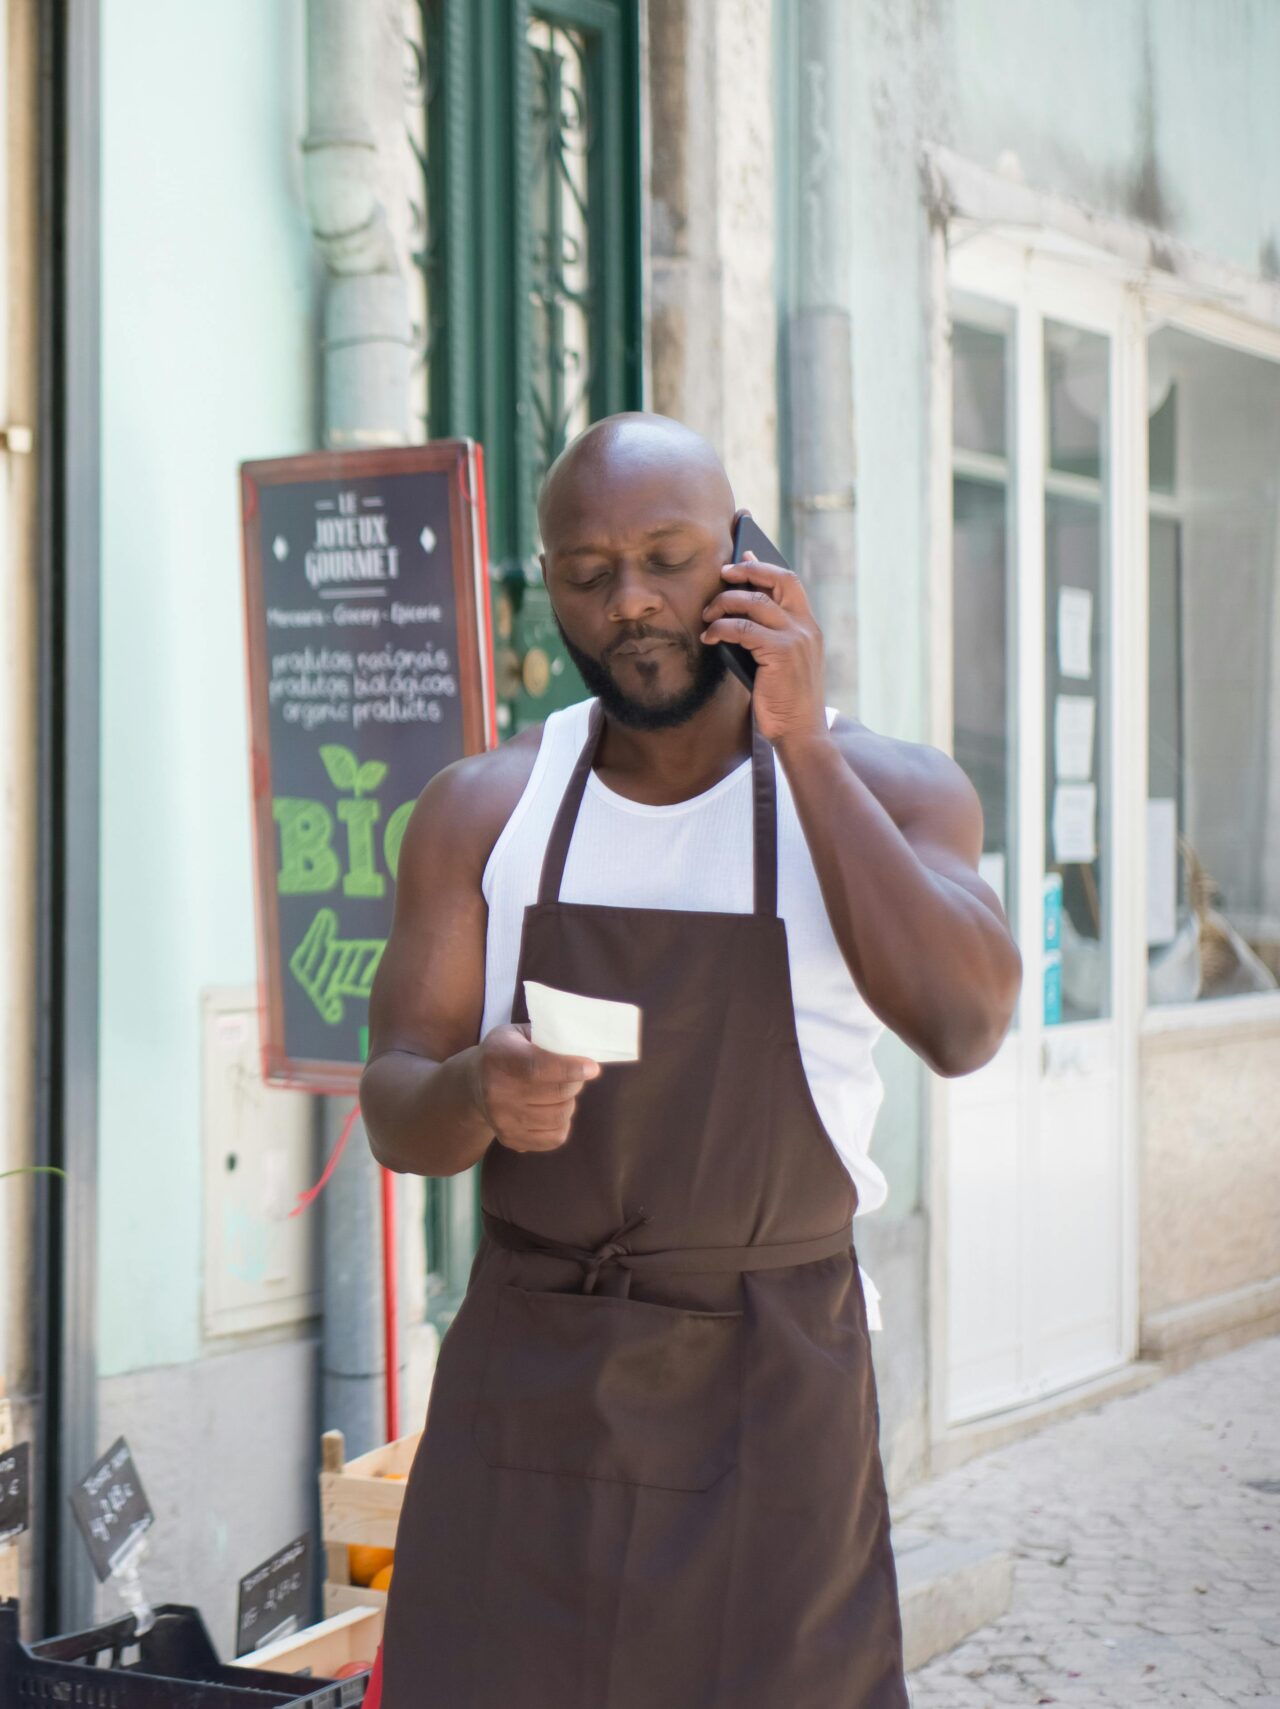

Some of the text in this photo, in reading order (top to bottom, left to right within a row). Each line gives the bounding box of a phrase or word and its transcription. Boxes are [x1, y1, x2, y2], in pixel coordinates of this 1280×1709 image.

[338, 492, 357, 516] LE
[314, 514, 388, 550] JOYEUX
[304, 546, 400, 589] GOURMET
